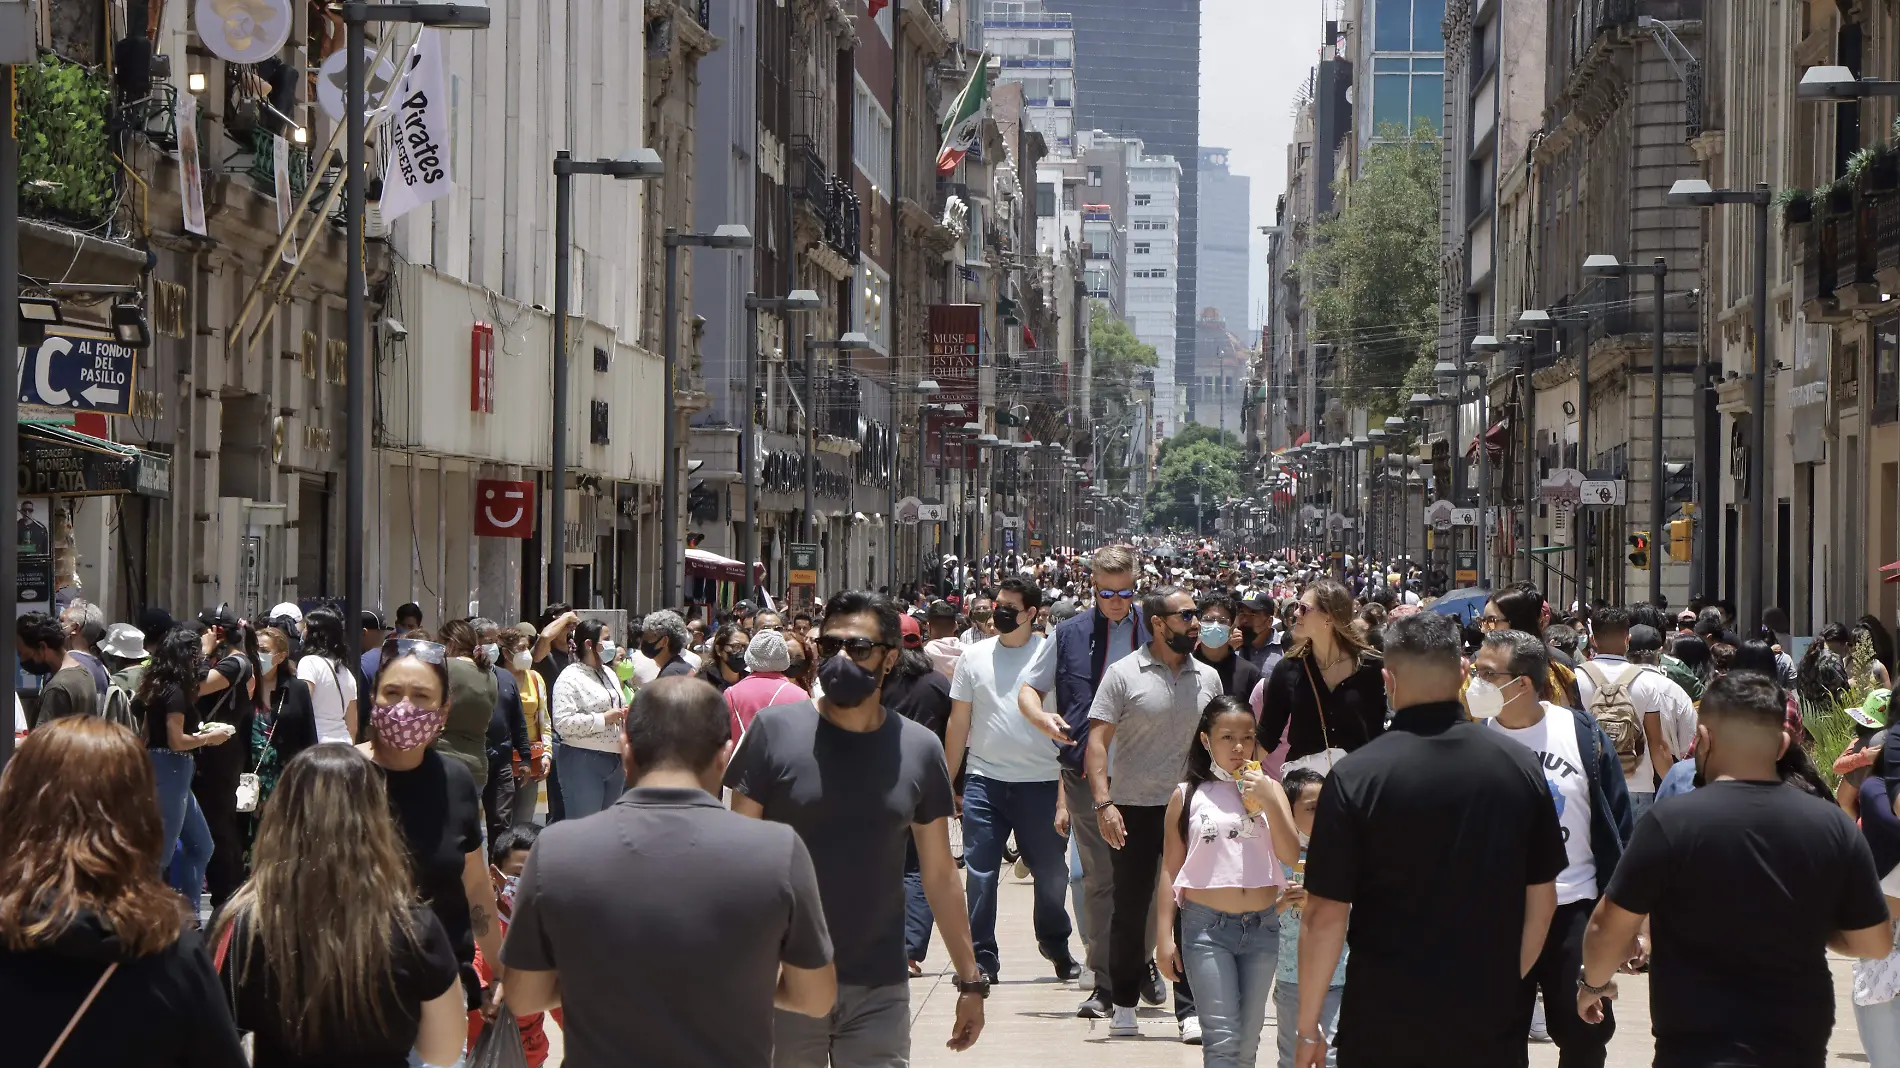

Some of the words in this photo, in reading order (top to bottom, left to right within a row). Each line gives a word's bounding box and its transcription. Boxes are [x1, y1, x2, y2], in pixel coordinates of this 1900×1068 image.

[401, 90, 444, 184] Pirates
[78, 341, 92, 355] AL
[96, 342, 131, 359] FONDO
[944, 345, 966, 355] DEL
[94, 356, 114, 370] DEL
[933, 356, 975, 367] ESTAN
[80, 367, 125, 385] PASILLO
[35, 457, 84, 472] MONEDAS
[35, 470, 87, 492] PLATA
